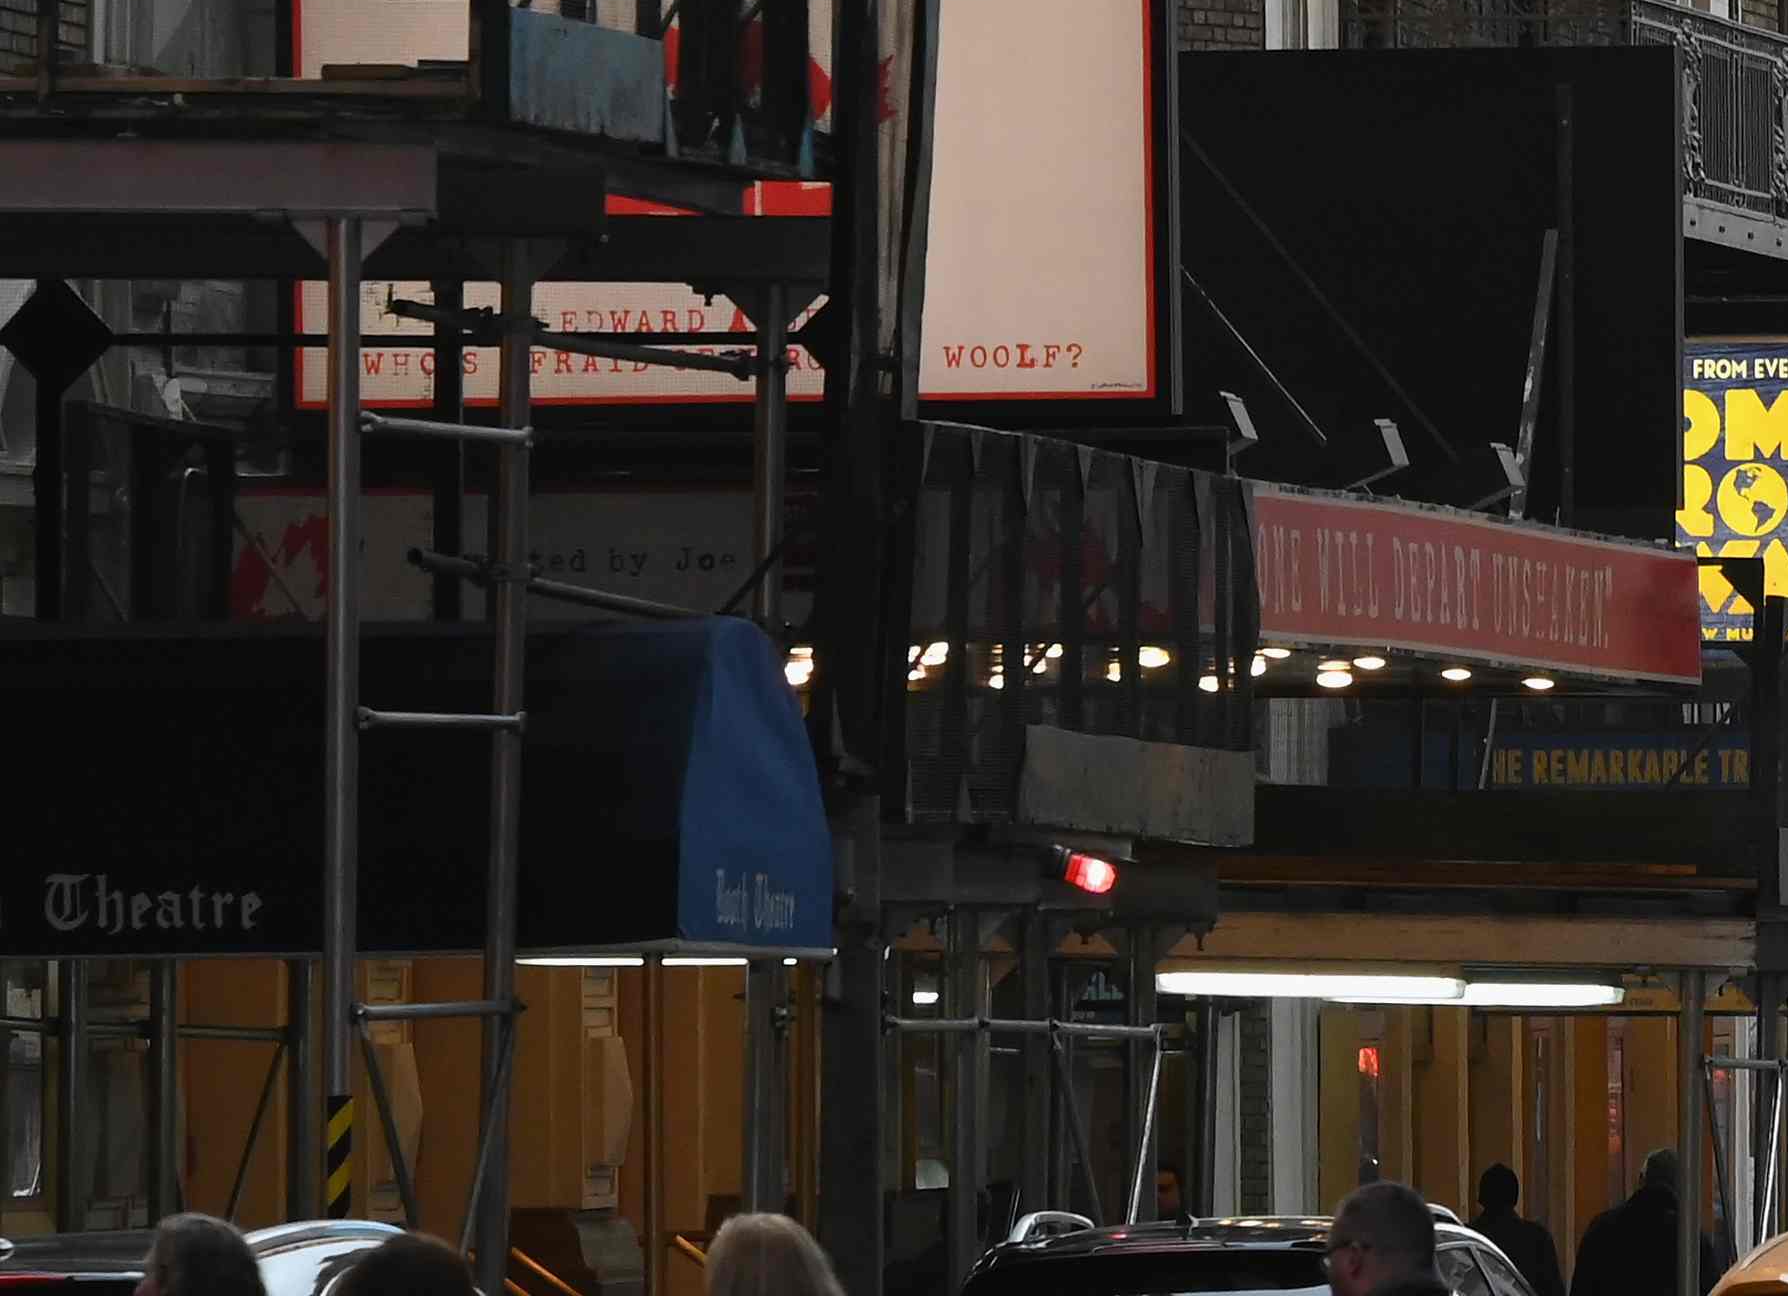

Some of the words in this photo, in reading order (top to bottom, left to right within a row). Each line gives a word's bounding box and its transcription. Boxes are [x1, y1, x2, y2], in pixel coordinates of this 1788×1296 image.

[560, 310, 706, 333] EDWARD
[943, 343, 1083, 370] WOOLF?
[1693, 359, 1747, 379] FROM
[610, 548, 647, 576] by
[677, 547, 737, 572] Joe
[1314, 528, 1379, 617] WILL
[1393, 536, 1480, 631] DEPART
[43, 872, 264, 936] Theatre
